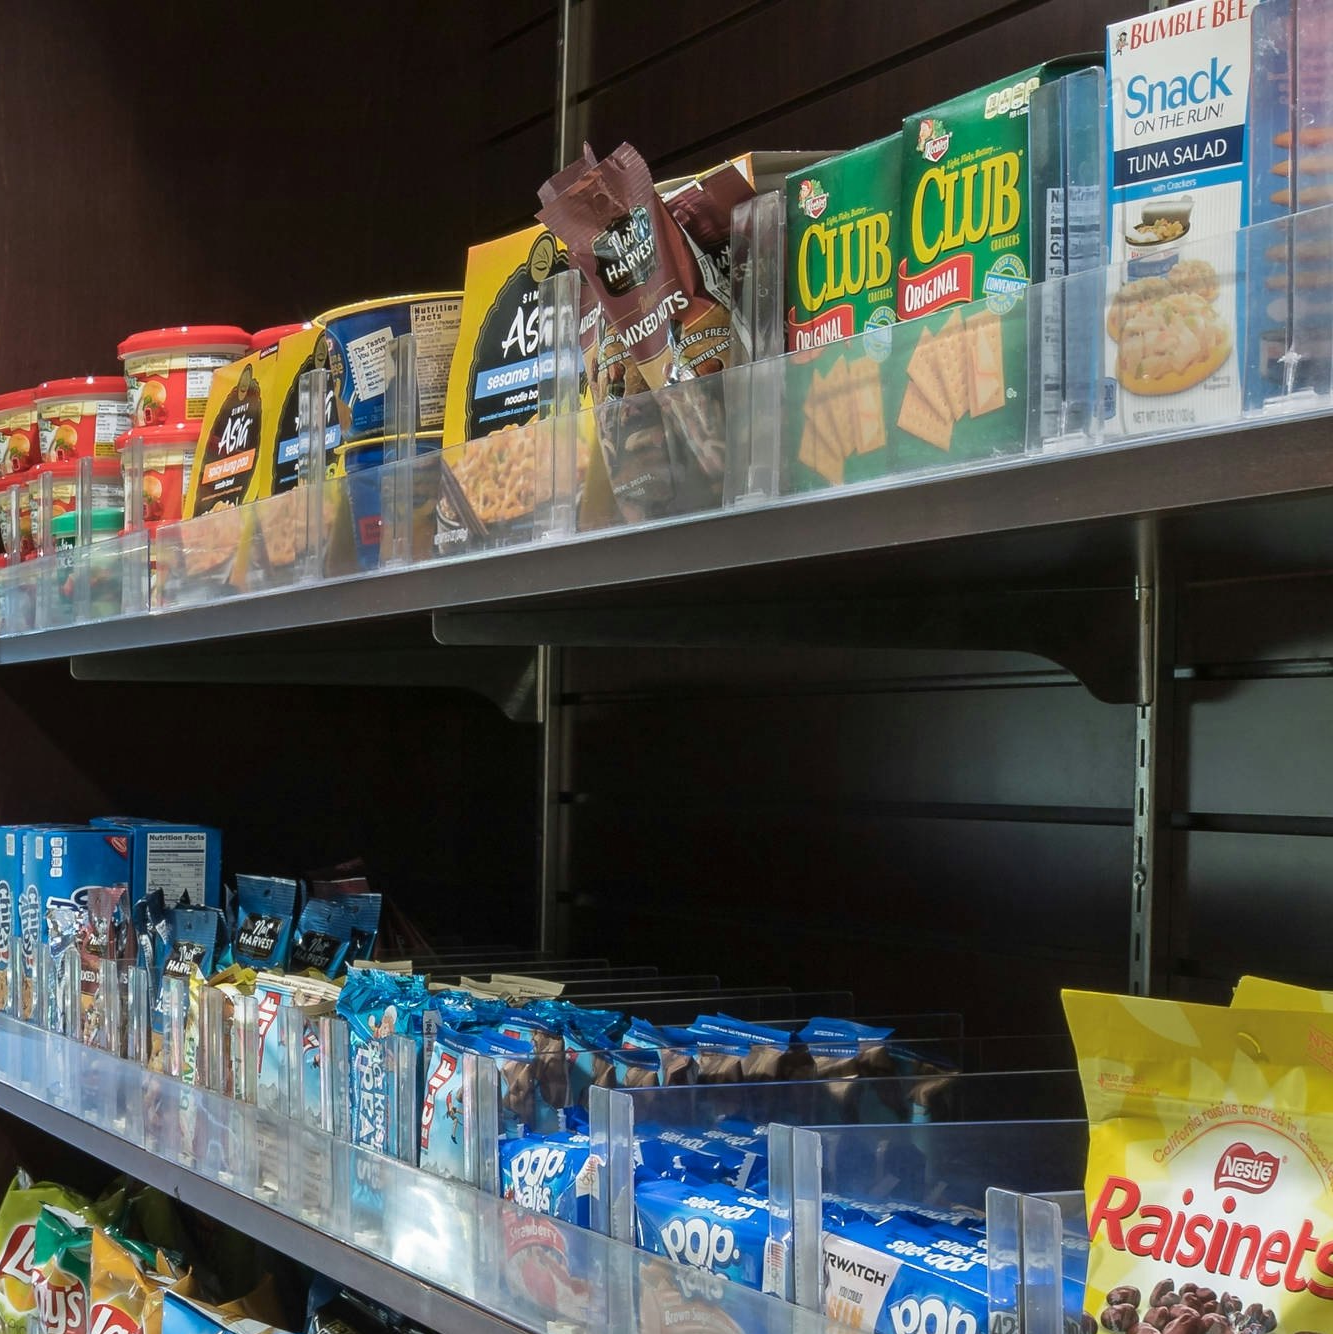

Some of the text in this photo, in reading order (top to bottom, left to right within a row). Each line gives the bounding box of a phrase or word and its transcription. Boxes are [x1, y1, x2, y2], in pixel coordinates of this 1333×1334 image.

[1130, 0, 1250, 50] BUMBLE BEE
[1125, 56, 1233, 119] Snack
[1133, 103, 1224, 136] ON THE RUN!
[1127, 138, 1227, 175] TUNA SALAD
[1152, 179, 1197, 194] with Crackers
[911, 151, 1021, 264] CLUB
[607, 221, 642, 256] Nut
[990, 234, 1021, 252] CRACKERS
[605, 233, 656, 283] HARVEST
[797, 212, 892, 312] CLUB
[867, 288, 893, 303] CRACKERS
[904, 268, 960, 313] ORIGINAL
[414, 303, 459, 314] Nutrition
[414, 312, 442, 321] Facts
[621, 289, 690, 349] MIXED NUTS
[353, 335, 386, 354] The Taste
[796, 316, 844, 350] ORIGINAL
[357, 348, 369, 360] You
[486, 367, 530, 390] sesame
[231, 403, 249, 417] SIMPLY
[504, 391, 528, 406] noodle
[208, 456, 249, 479] spicy pao
[148, 833, 206, 842] Nutrition Facts
[253, 918, 275, 938] Nut
[238, 932, 274, 951] HARVEST
[1152, 1103, 1297, 1165] California raisins covered in
[1087, 1174, 1333, 1301] Raisinets
